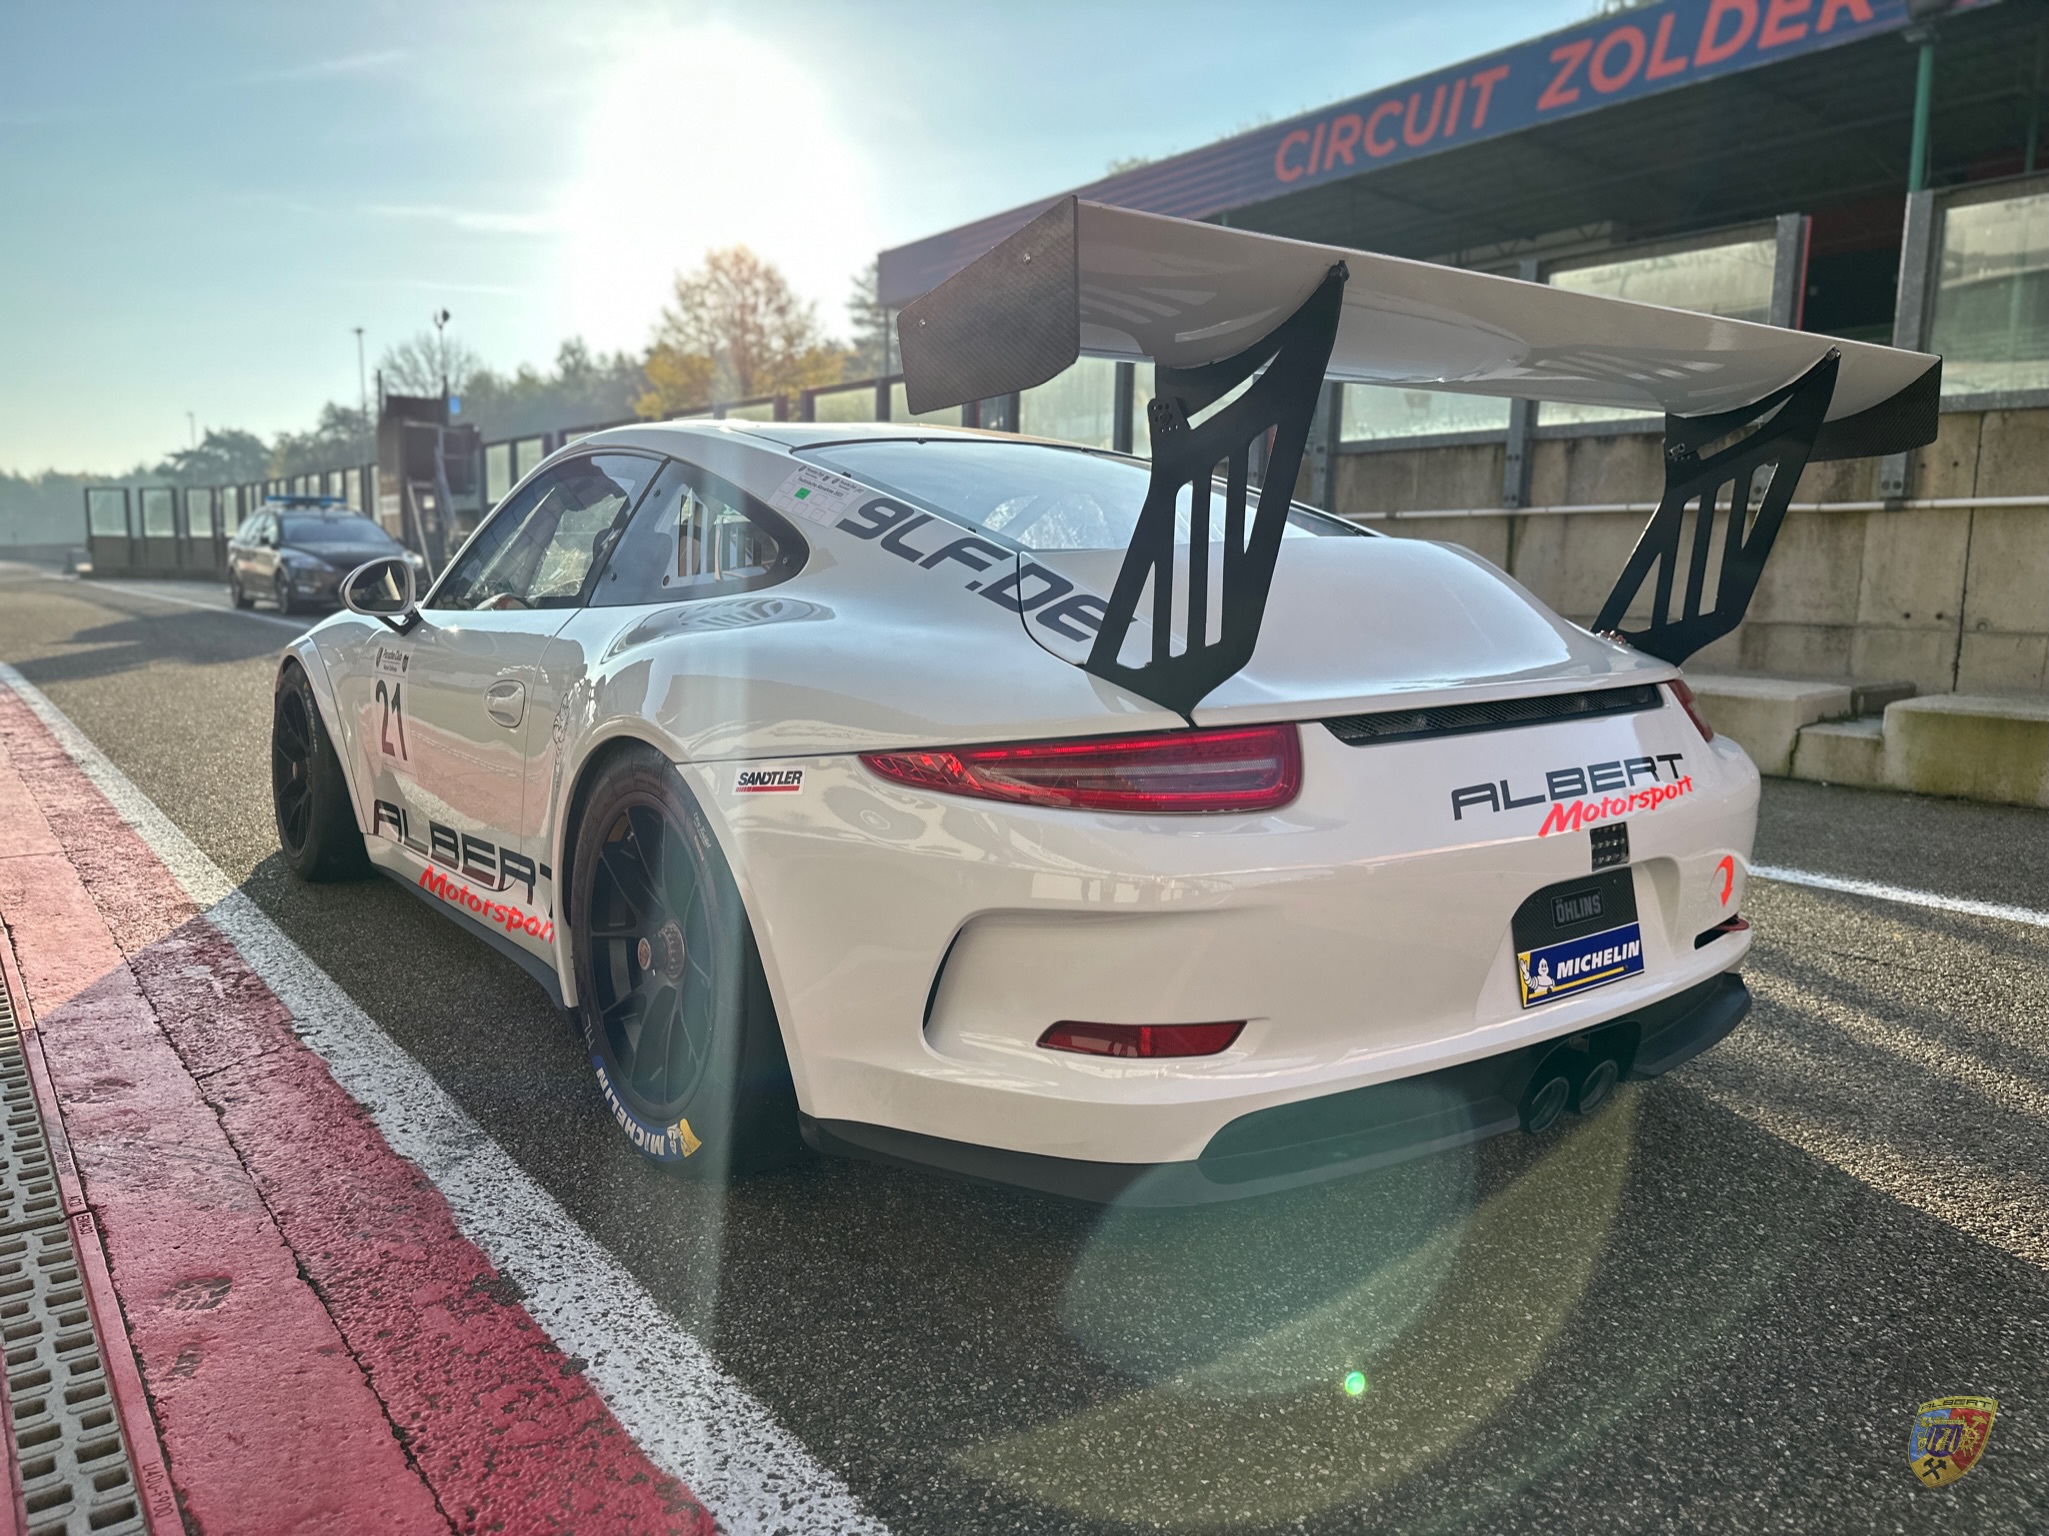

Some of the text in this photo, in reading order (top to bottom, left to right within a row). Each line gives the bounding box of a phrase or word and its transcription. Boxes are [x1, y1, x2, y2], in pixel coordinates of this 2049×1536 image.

[1274, 66, 1509, 183] CIRCUIT
[375, 679, 408, 761] 21
[738, 770, 803, 786] SANDTLER
[1451, 753, 1683, 821] ALBERT
[1538, 775, 1693, 838] Motorsport
[1554, 894, 1601, 924] ÖHLINS
[1556, 940, 1640, 980] MICHELIN
[596, 1067, 665, 1156] MICHELIN
